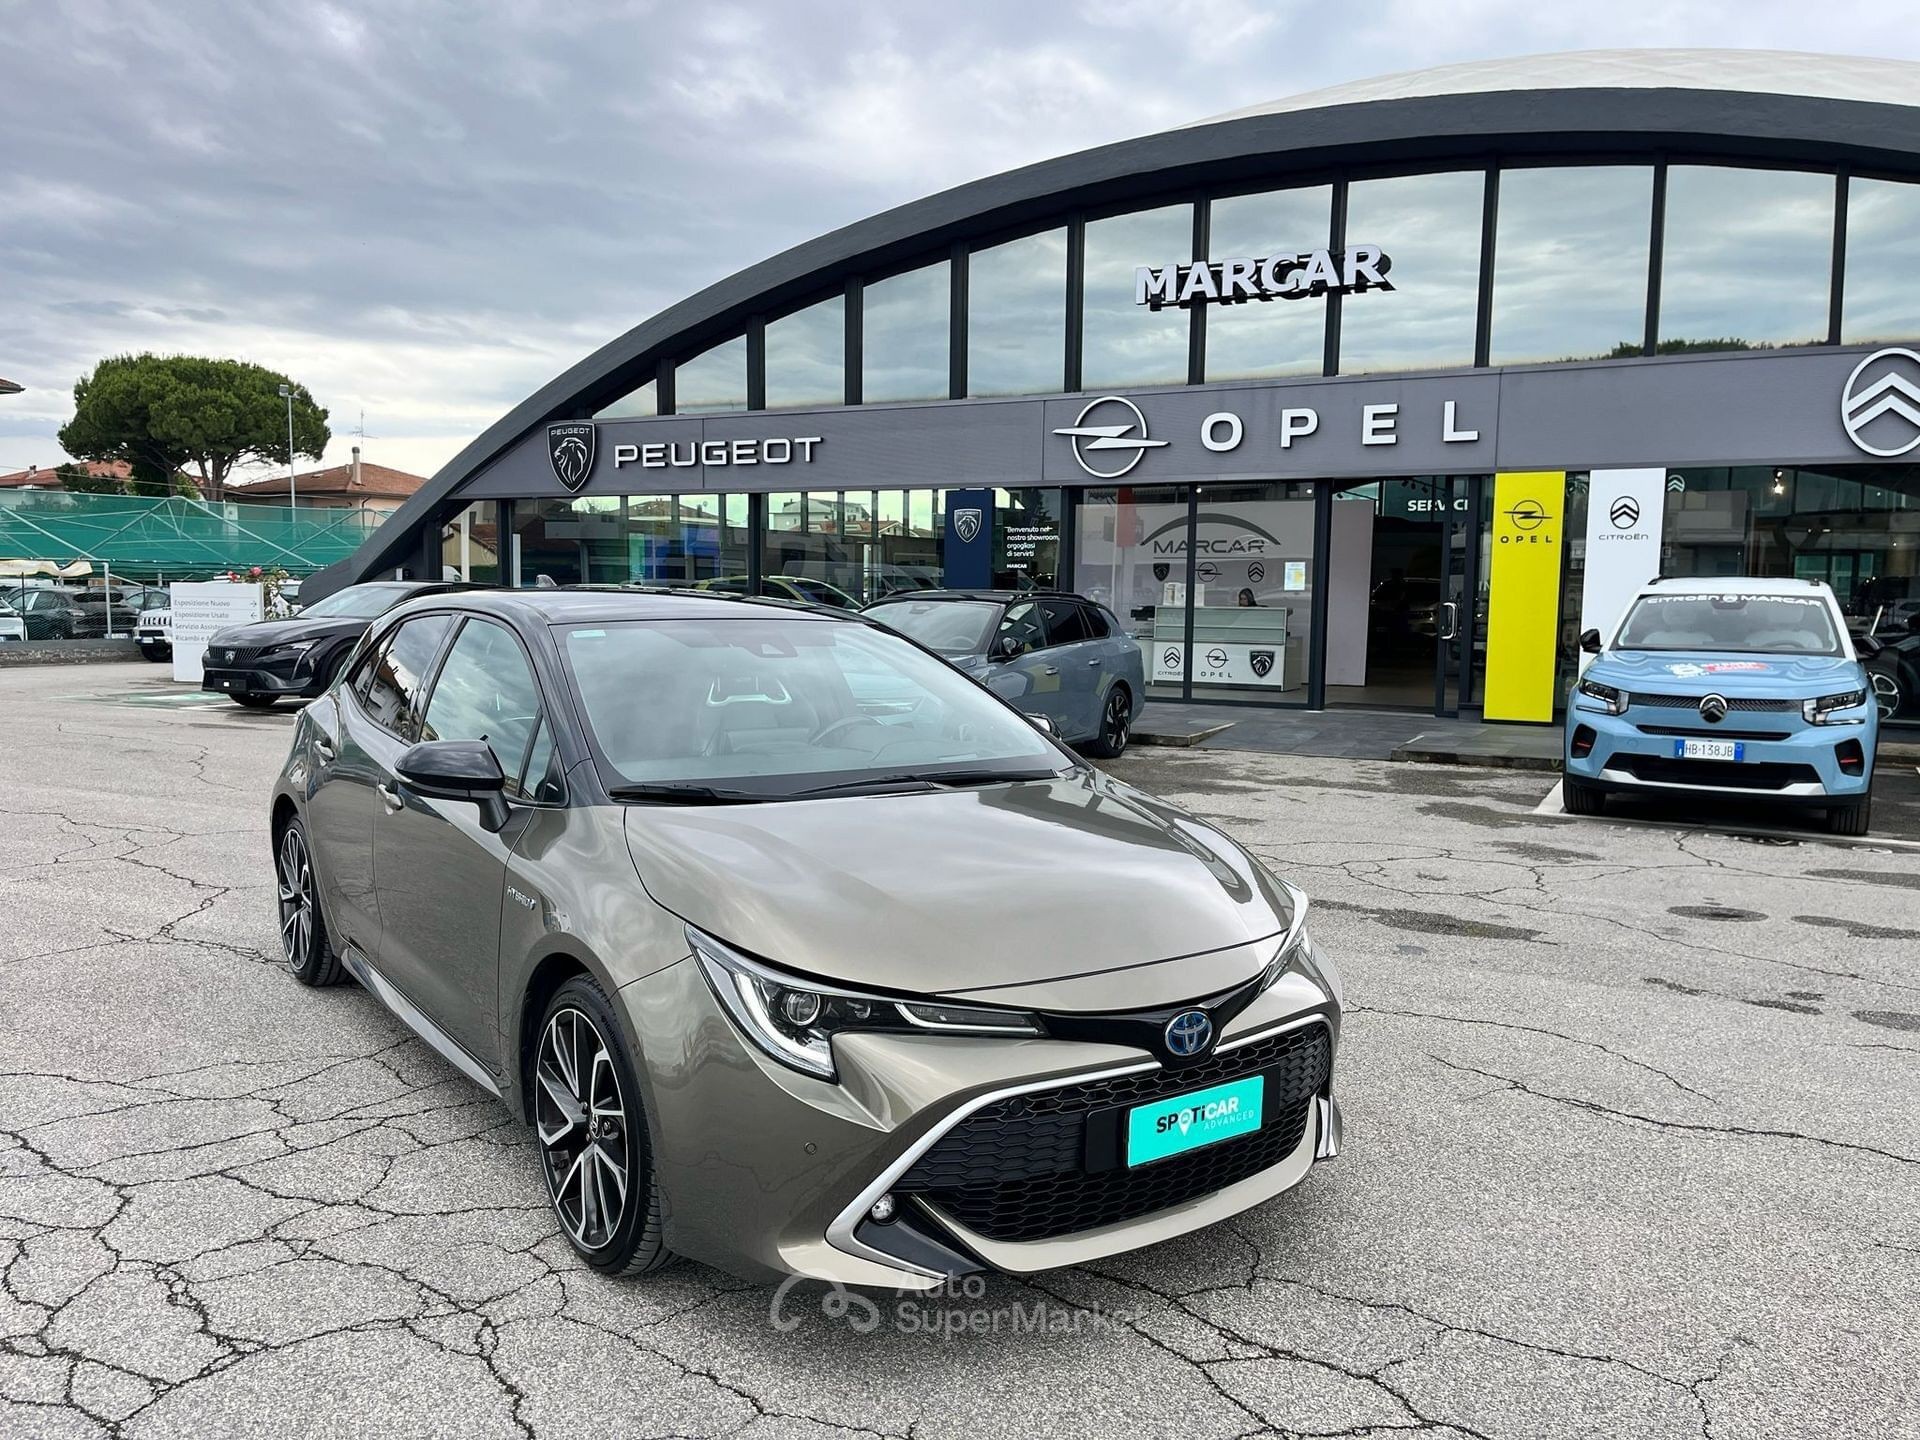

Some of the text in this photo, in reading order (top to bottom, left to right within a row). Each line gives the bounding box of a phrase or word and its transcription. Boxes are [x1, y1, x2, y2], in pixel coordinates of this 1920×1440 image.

[1136, 244, 1388, 305] MARCAR
[550, 427, 590, 436] PEUGEOT
[1200, 400, 1480, 452] OPEL
[614, 436, 821, 469] PEUGEOT
[1500, 535, 1553, 544] OPEL
[1153, 540, 1265, 554] MARCAR
[174, 600, 209, 608] Esposizione
[1741, 594, 1822, 608] MARCAR
[174, 611, 210, 619] Esposizione
[1203, 1109, 1254, 1131] ADVANCED
